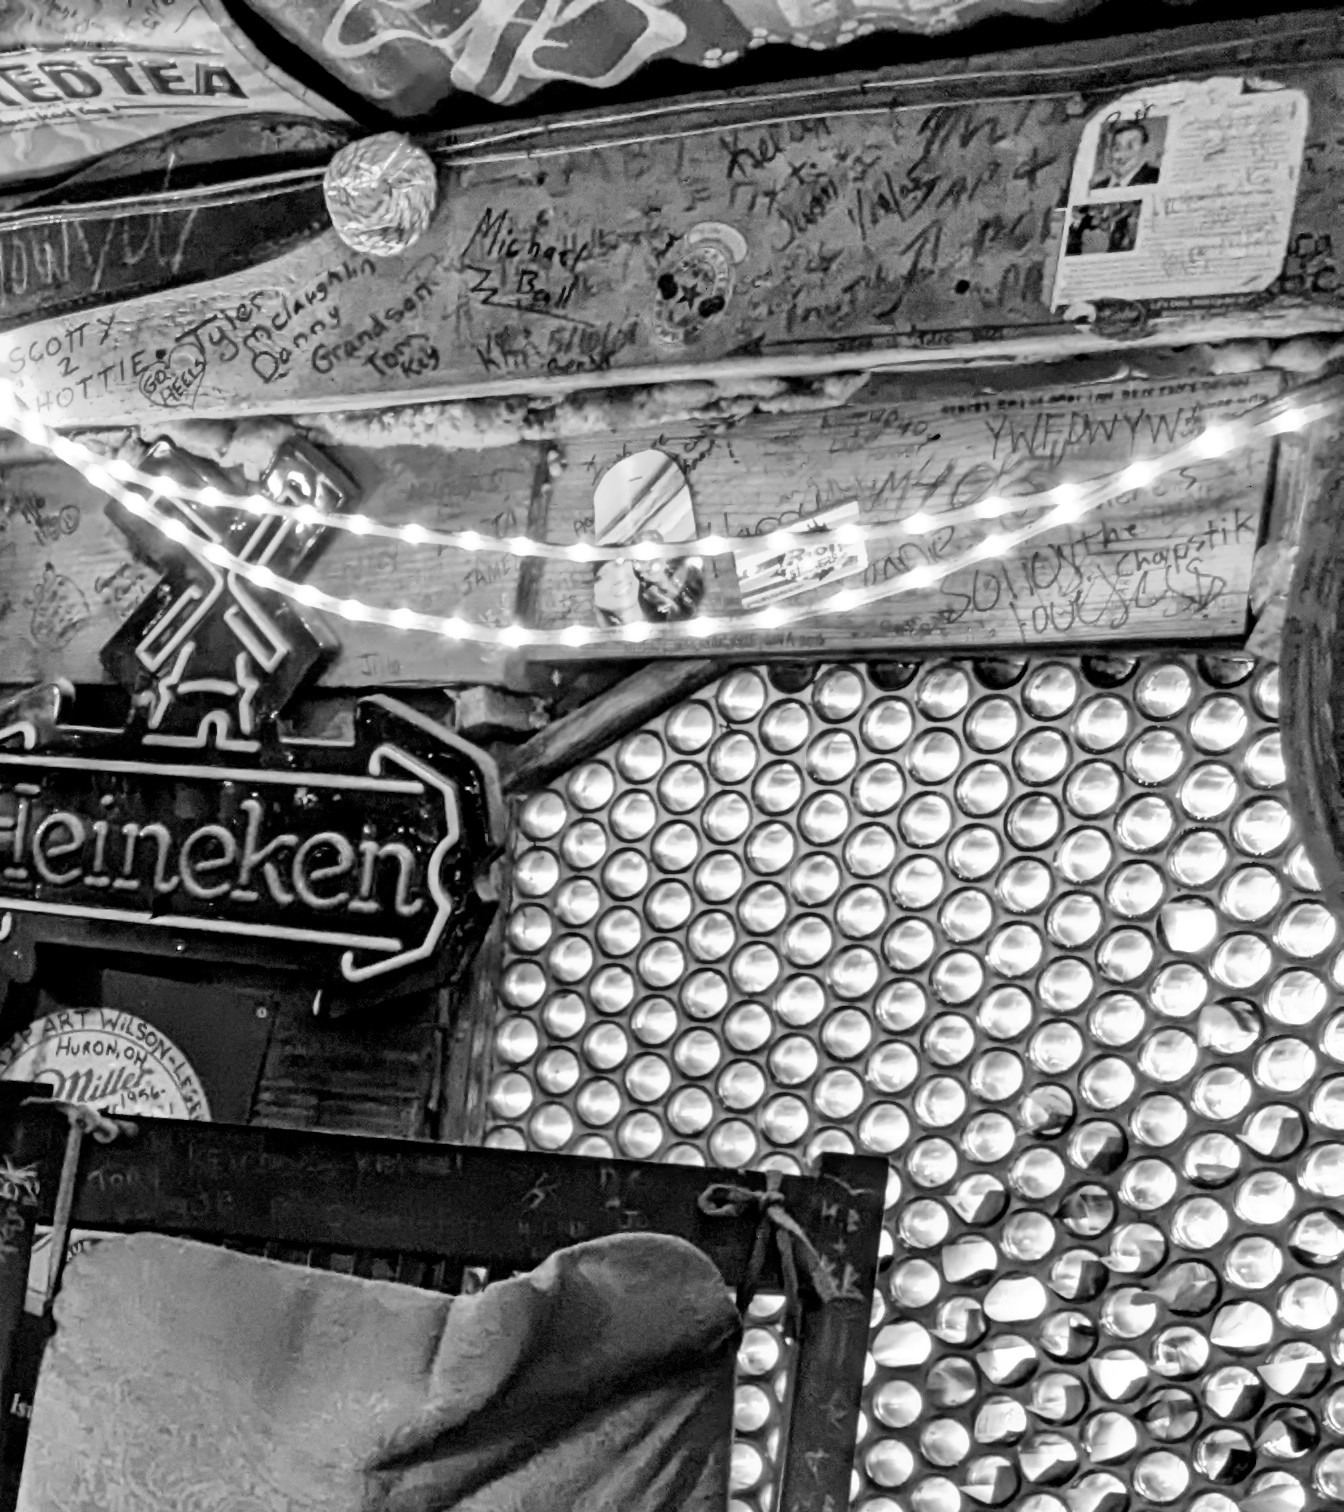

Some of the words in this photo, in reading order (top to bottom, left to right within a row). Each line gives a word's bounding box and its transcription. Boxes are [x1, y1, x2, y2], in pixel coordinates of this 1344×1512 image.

[89, 55, 249, 100] TEA
[8, 312, 118, 374] SCOTTY
[35, 349, 146, 412] HOTTIE
[42, 1008, 92, 1035] ART
[33, 1066, 154, 1101] Miller
